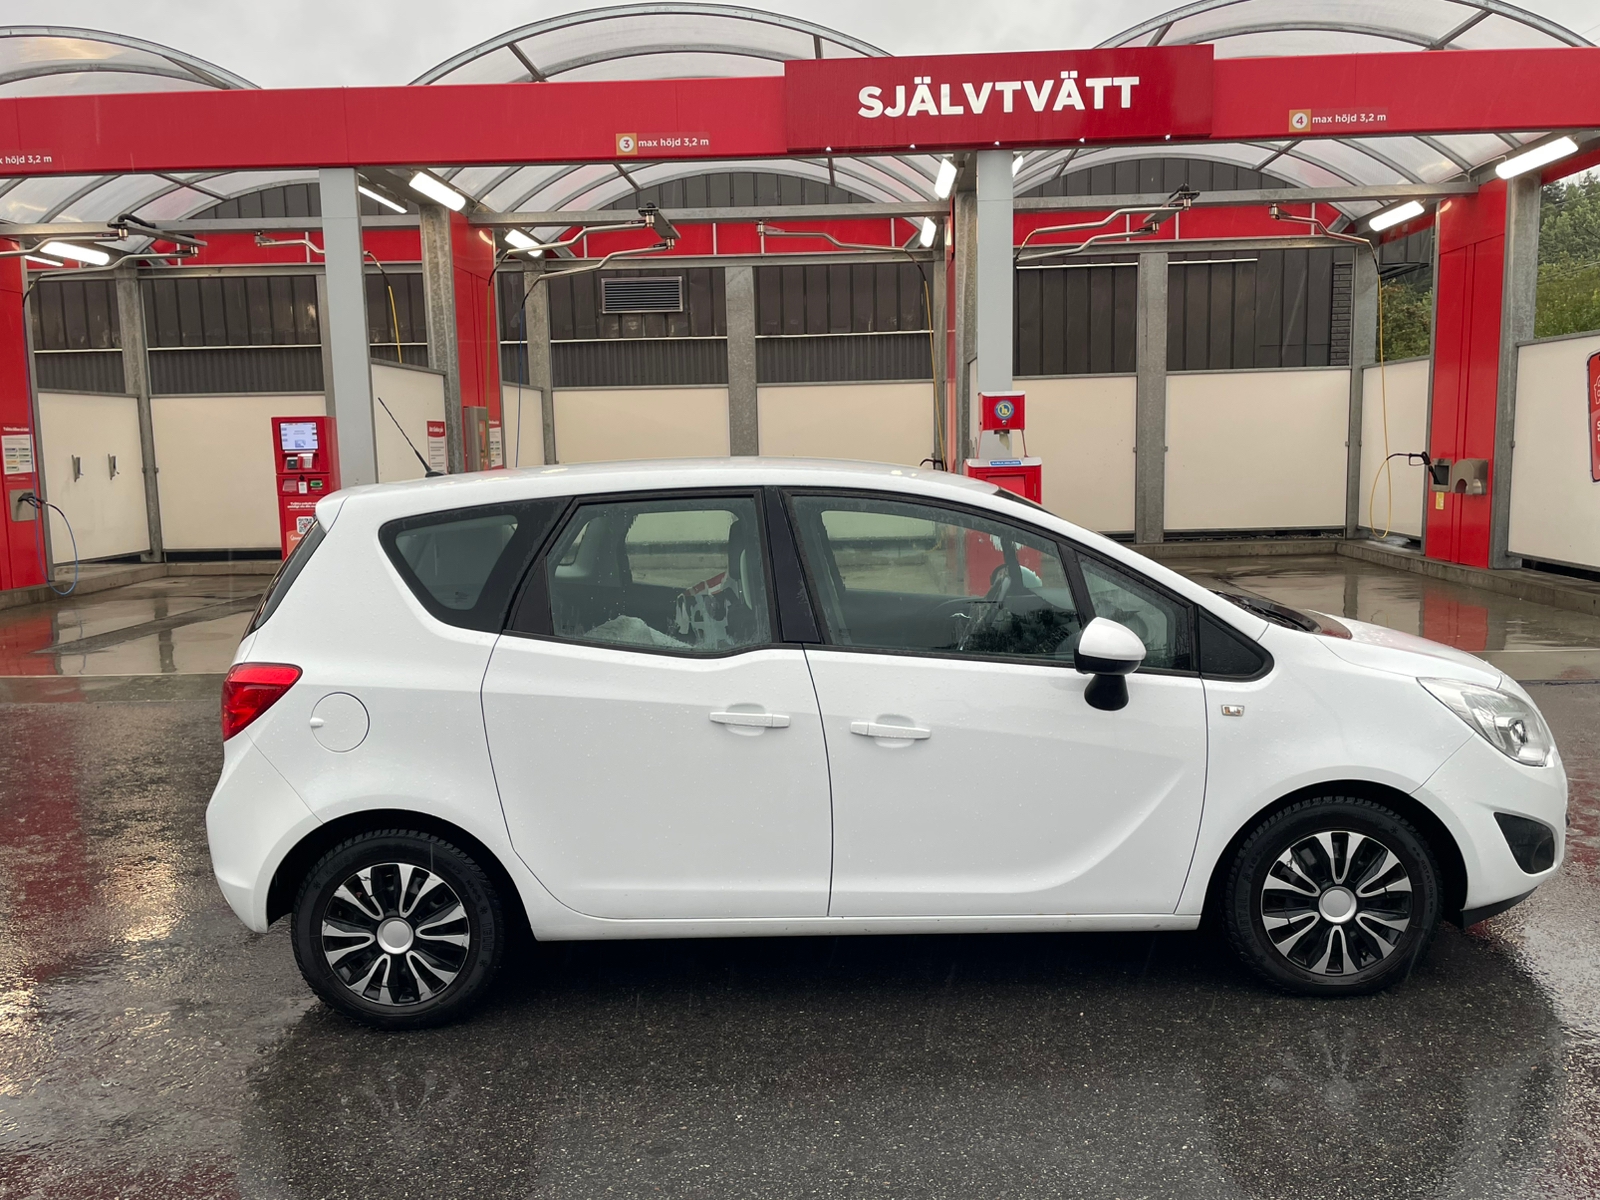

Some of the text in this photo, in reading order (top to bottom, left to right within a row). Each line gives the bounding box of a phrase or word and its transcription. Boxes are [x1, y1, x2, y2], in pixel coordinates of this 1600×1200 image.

[858, 70, 1140, 118] SJÄLVTVÄTT
[1296, 116, 1304, 125] 4
[1312, 115, 1332, 124] max
[1335, 113, 1357, 124] höjd
[1359, 113, 1375, 123] 3,2
[623, 137, 709, 149] 3 max höjd 3,2 m
[5, 155, 26, 165] höjd
[27, 155, 42, 164] 3,2
[43, 155, 52, 163] m
[1420, 859, 1434, 898] ROTATION
